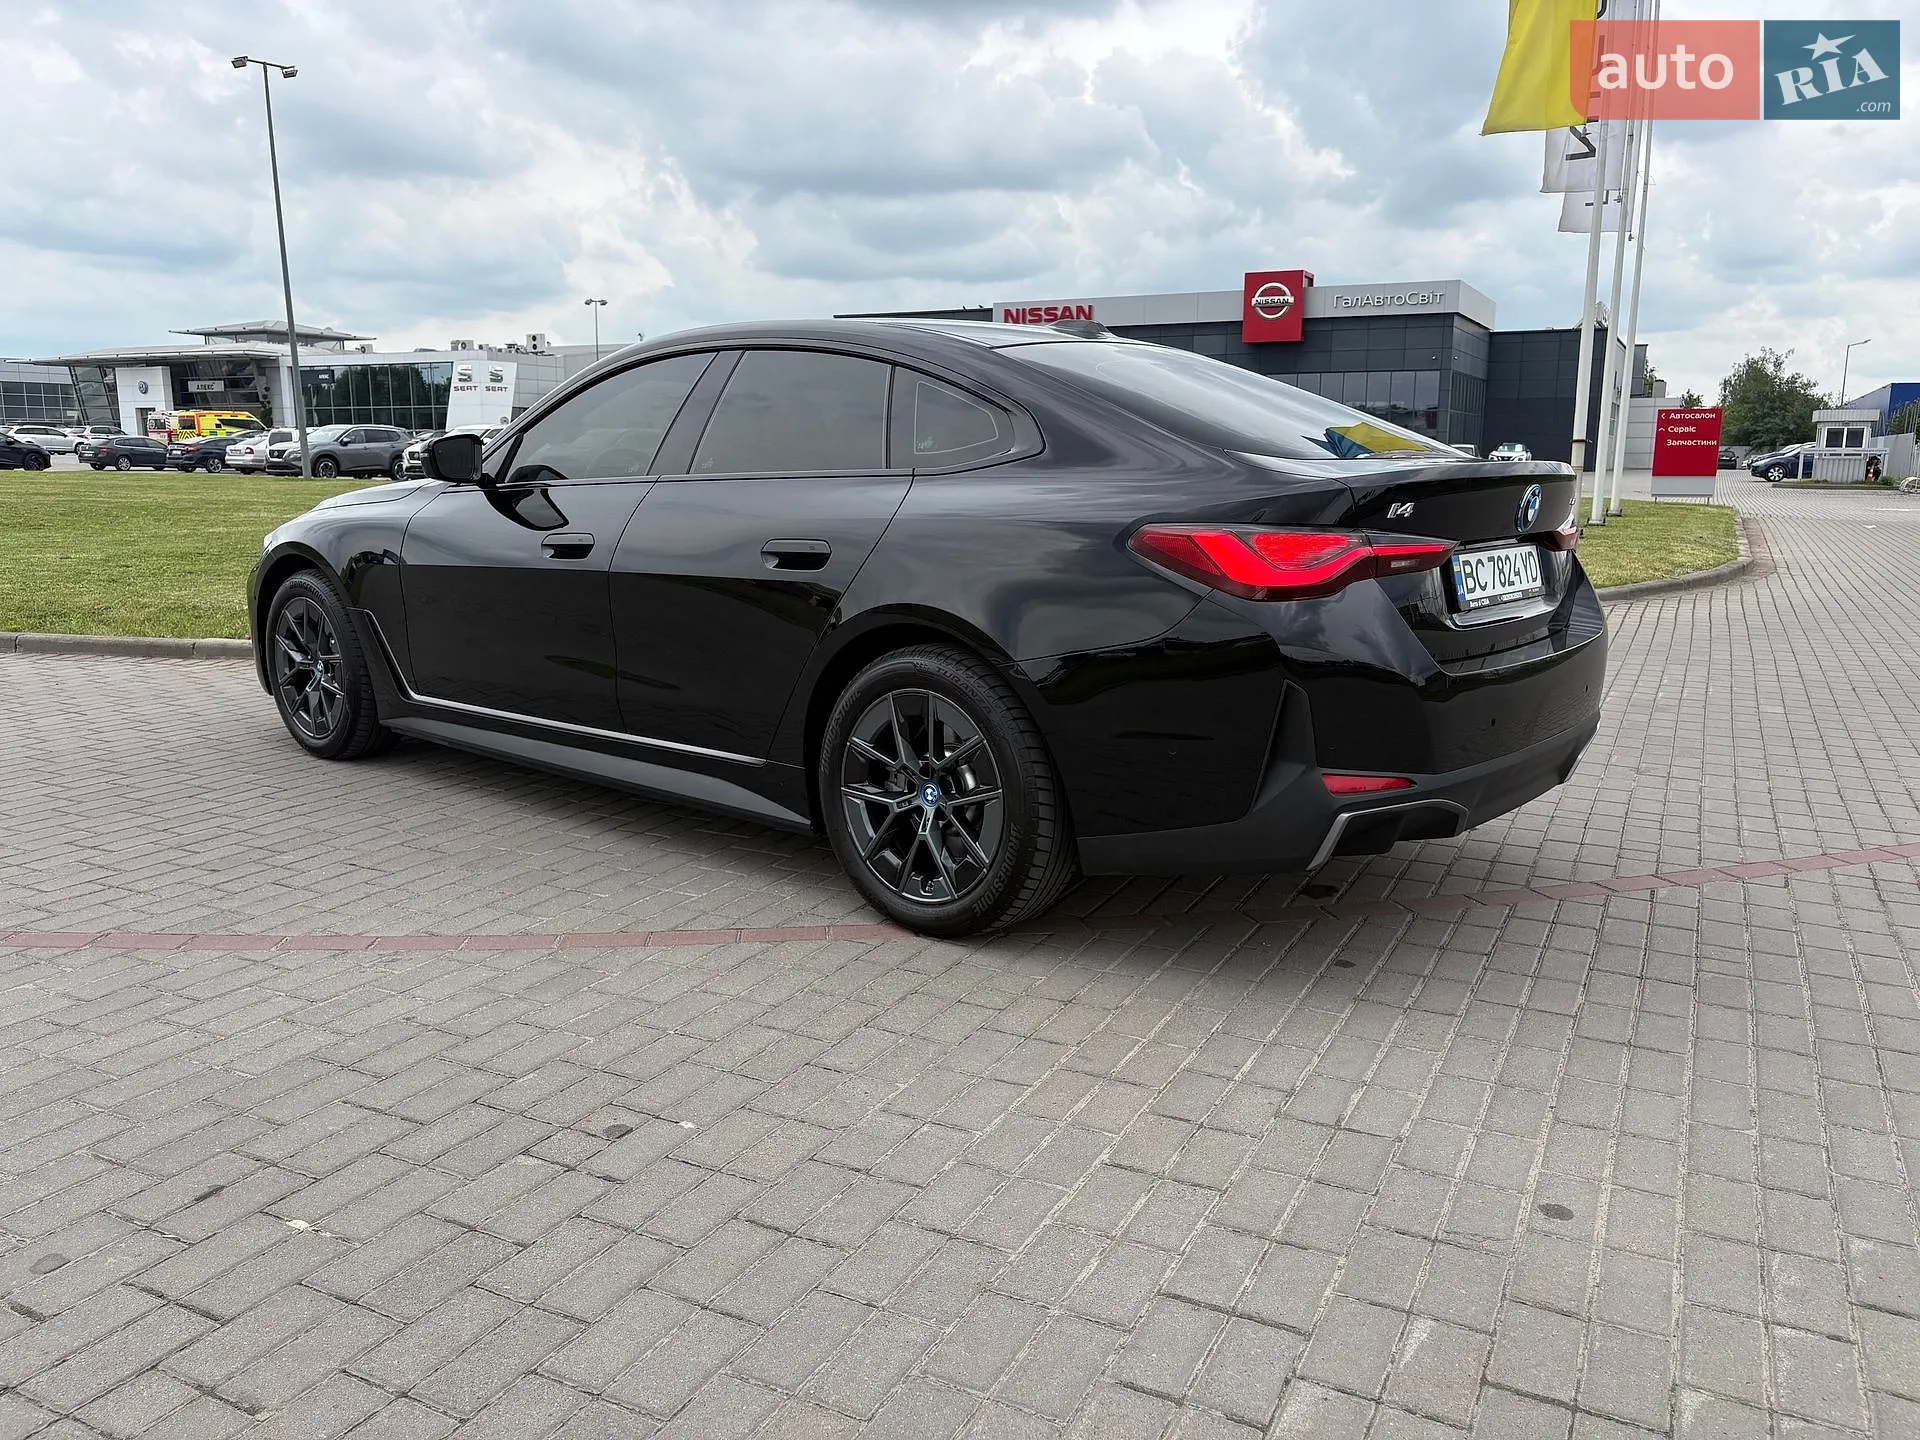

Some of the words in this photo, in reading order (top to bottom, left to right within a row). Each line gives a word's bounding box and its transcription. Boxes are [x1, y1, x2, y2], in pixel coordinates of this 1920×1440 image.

[1333, 290, 1445, 308] ГалАвтоСвіт
[1003, 304, 1094, 324] NISSAN
[1669, 412, 1716, 420] Автосалон
[1667, 425, 1697, 434] Сервіс
